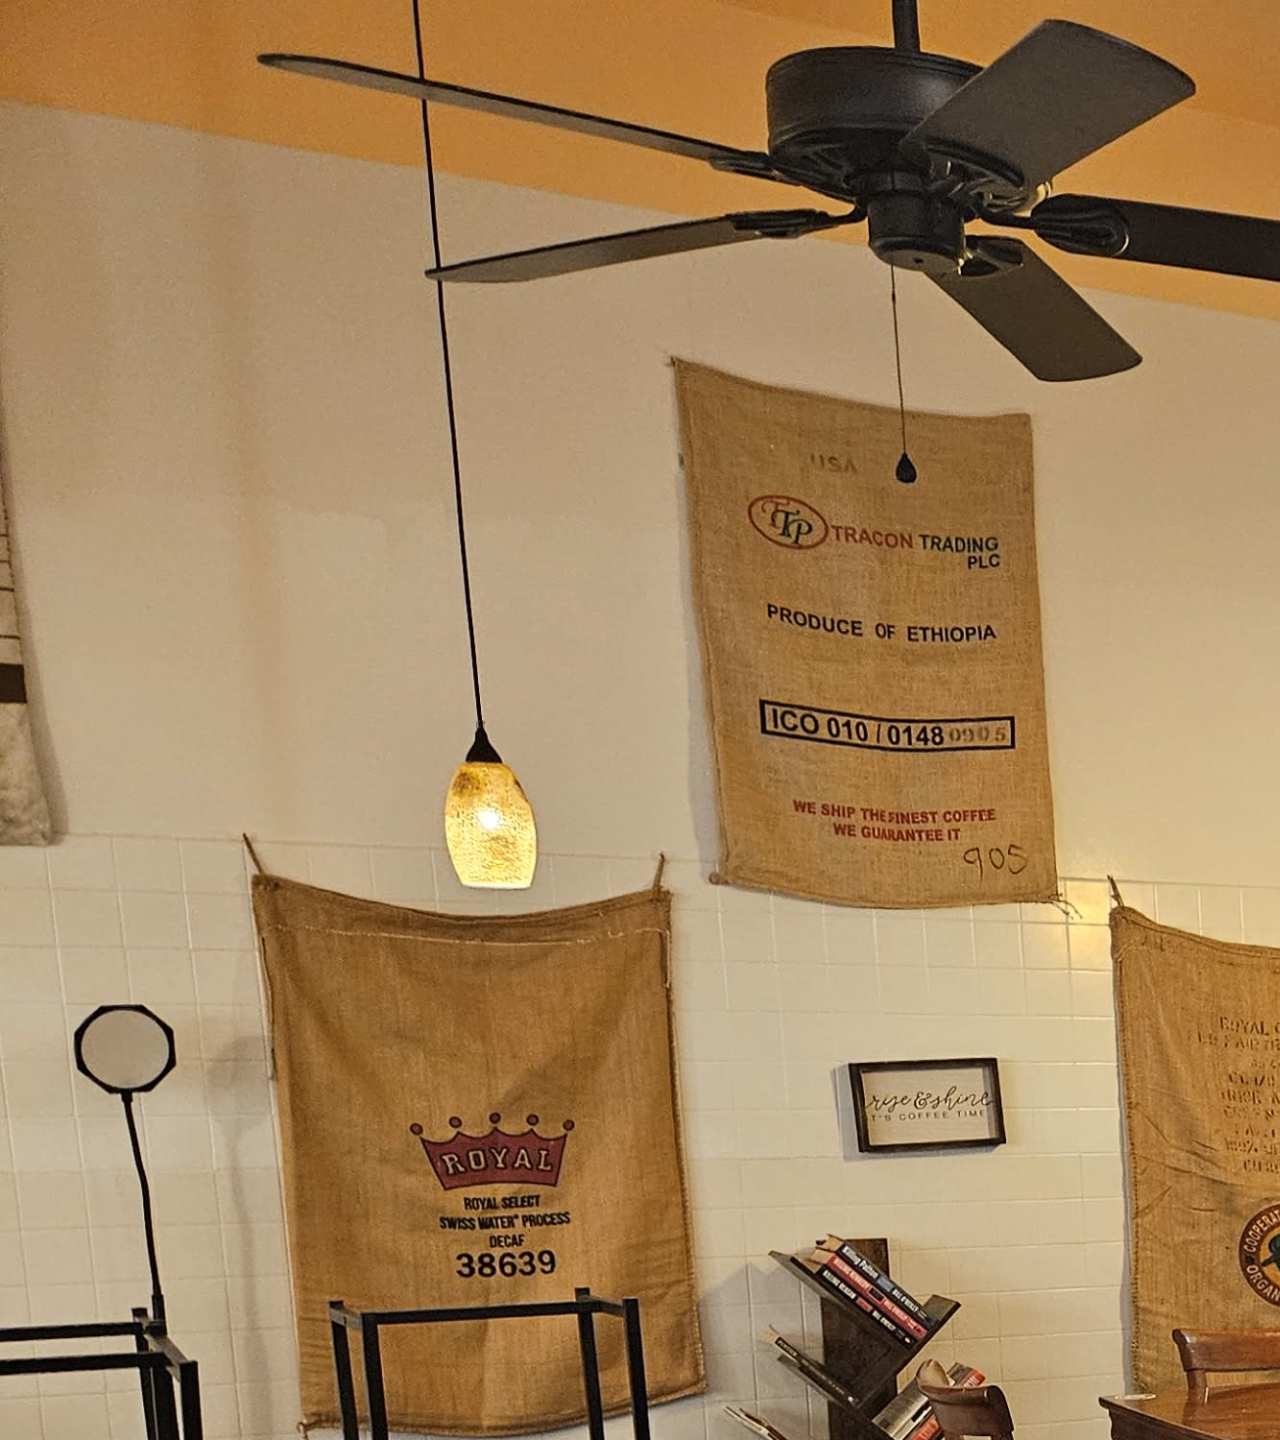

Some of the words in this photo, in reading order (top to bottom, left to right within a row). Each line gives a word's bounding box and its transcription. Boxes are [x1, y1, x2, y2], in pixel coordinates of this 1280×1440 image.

[831, 524, 914, 549] TRACON
[918, 534, 999, 554] TRADING
[968, 554, 1000, 570] PLC
[767, 602, 863, 637] PRODUCE
[875, 622, 896, 641] OF
[907, 624, 997, 643] ETHIOPIA
[771, 707, 820, 735] ICO
[827, 716, 869, 743] 010
[876, 723, 882, 745] /
[887, 725, 945, 747] 0148
[793, 799, 817, 816] WE
[821, 803, 856, 819] SHIP
[943, 808, 996, 823] COFFEE
[833, 823, 857, 837] WE
[861, 825, 943, 842] GUARANTEE
[947, 828, 961, 841] IT
[963, 844, 1028, 882] 905
[1219, 1016, 1269, 1037] ROYAL
[930, 1085, 995, 1111] shine
[898, 1110, 949, 1122] COFFEE
[441, 1149, 553, 1176] ROYAL
[463, 1197, 499, 1211] ROYAL
[501, 1195, 541, 1210] SELECT
[439, 1216, 476, 1231] SWISS
[522, 1211, 571, 1228] PROCESS
[489, 1233, 525, 1248] DECAF
[456, 1250, 557, 1278] 38639
